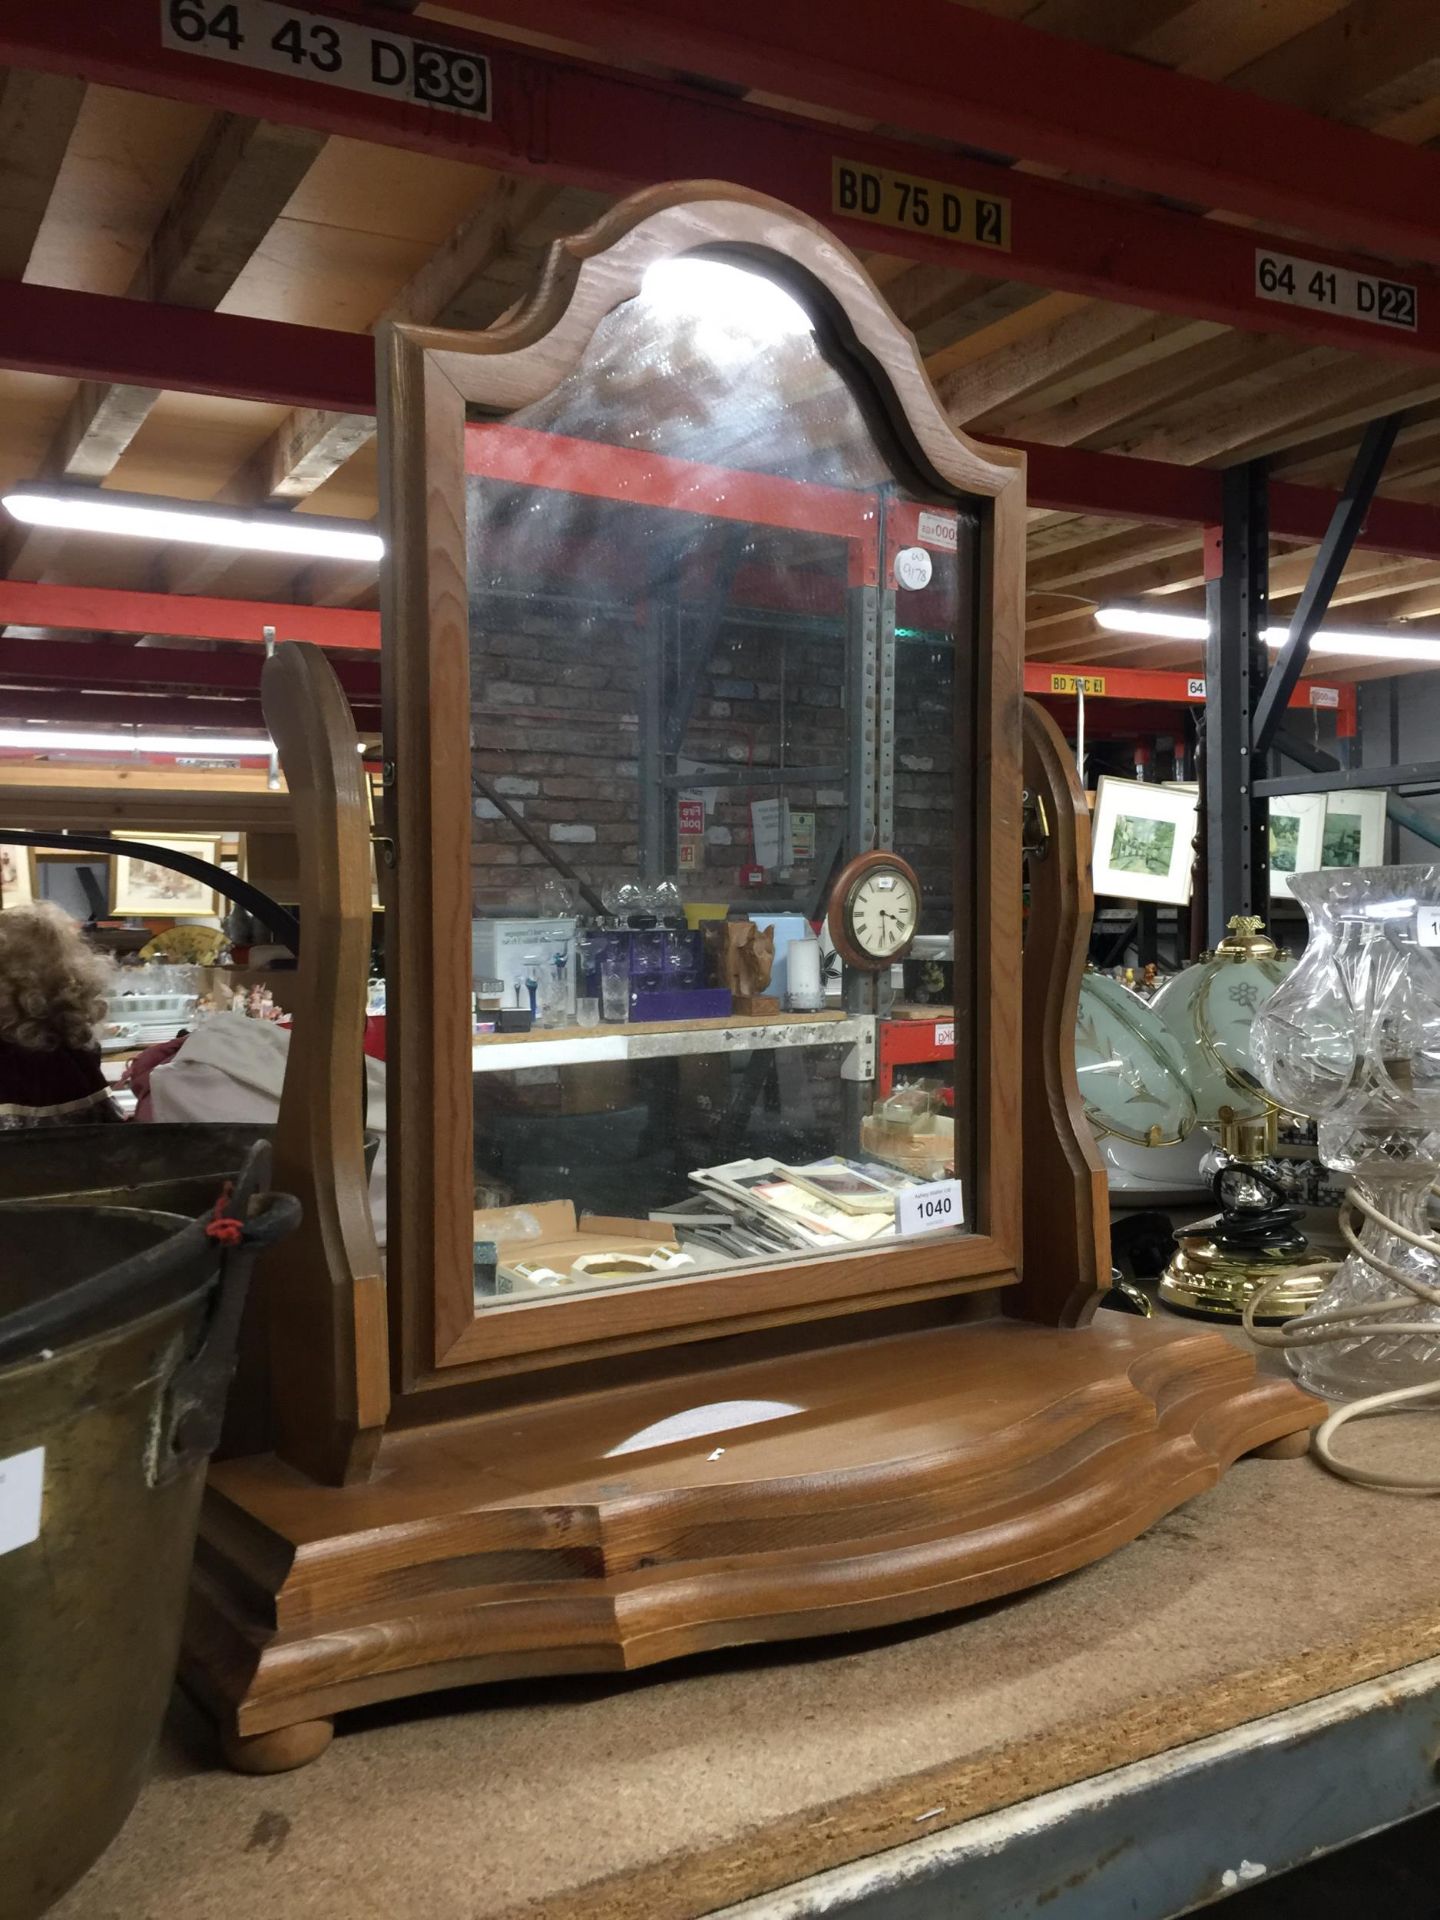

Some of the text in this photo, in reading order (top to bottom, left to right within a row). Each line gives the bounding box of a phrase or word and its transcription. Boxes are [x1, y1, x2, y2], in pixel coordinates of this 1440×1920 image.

[169, 0, 244, 51] 64
[271, 18, 343, 73] 43
[838, 167, 999, 244] BD 75 D 2
[1259, 259, 1296, 297] 64
[1308, 270, 1338, 306] 41
[1053, 677, 1066, 690] BD
[1189, 681, 1203, 694] 64
[917, 1198, 951, 1219] 1040
